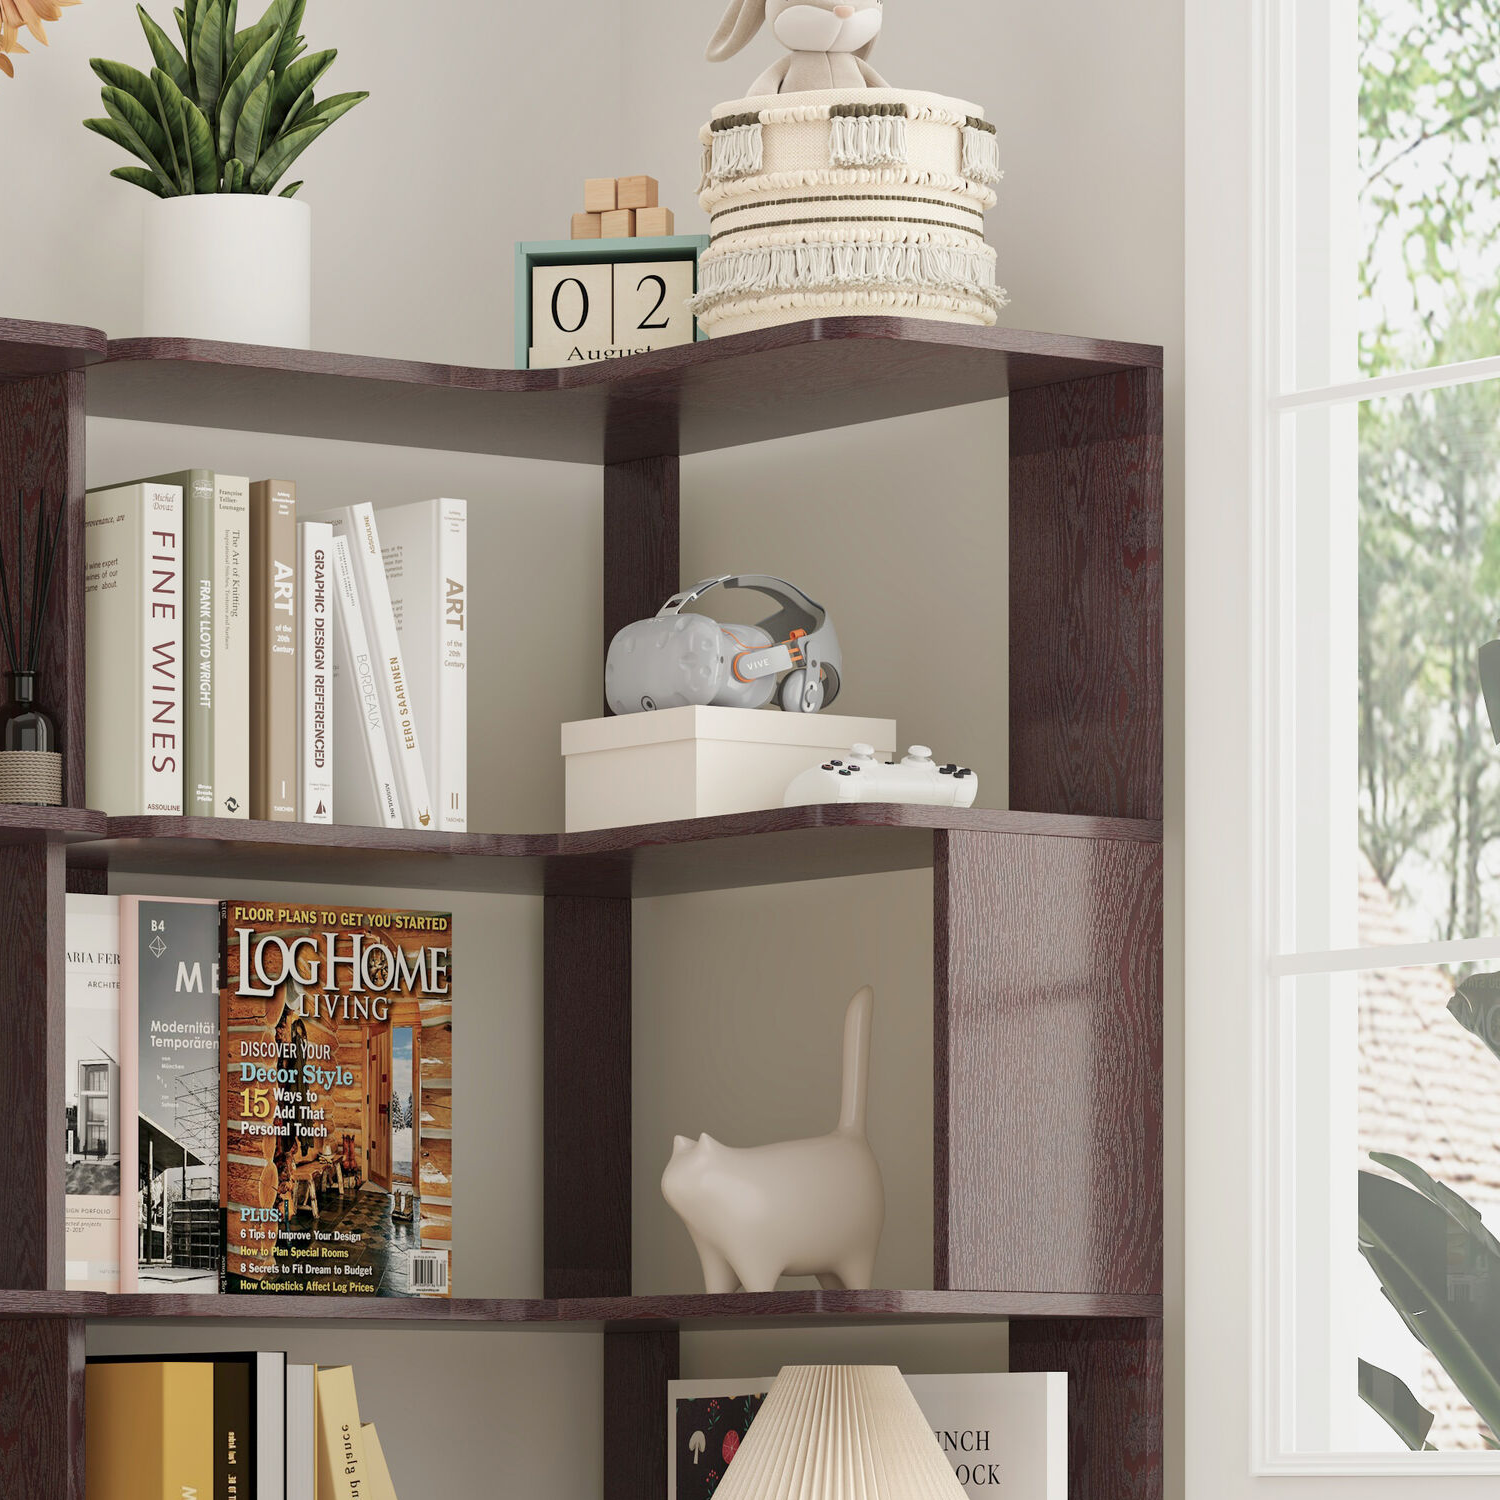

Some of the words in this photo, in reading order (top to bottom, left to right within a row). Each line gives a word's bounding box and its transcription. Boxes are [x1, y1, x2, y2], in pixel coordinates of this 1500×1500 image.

[152, 531, 175, 620] FINE
[274, 560, 293, 616] ART
[314, 549, 324, 613] GRAPHIC
[200, 579, 211, 618] FRANK
[446, 577, 464, 631] ART
[200, 621, 211, 658] LLOYD
[314, 618, 324, 670] DESIGN
[746, 657, 770, 671] VIVE
[200, 661, 211, 709] WRIGHT
[357, 654, 380, 730] BORDEAUX
[389, 656, 409, 716] SAARINEN
[152, 640, 175, 772] WINES
[314, 675, 324, 768] REFERENCED
[402, 720, 415, 750] EERO
[299, 994, 389, 1021] LIVING
[240, 1041, 297, 1059] DISCOVER
[301, 1043, 331, 1060] YOUR
[240, 1088, 270, 1118] 15
[273, 1105, 296, 1119] Add
[299, 1106, 324, 1121] That
[274, 1087, 302, 1102] Ways
[306, 1090, 317, 1103] to
[241, 1121, 290, 1136] Personal
[294, 1123, 327, 1137] Touch
[240, 1208, 283, 1222] PLUS:
[240, 1280, 258, 1290] How
[260, 1281, 303, 1292] Chopsticks
[306, 1281, 330, 1292] Affect
[332, 1282, 347, 1293] Log
[349, 1283, 374, 1293] Prices
